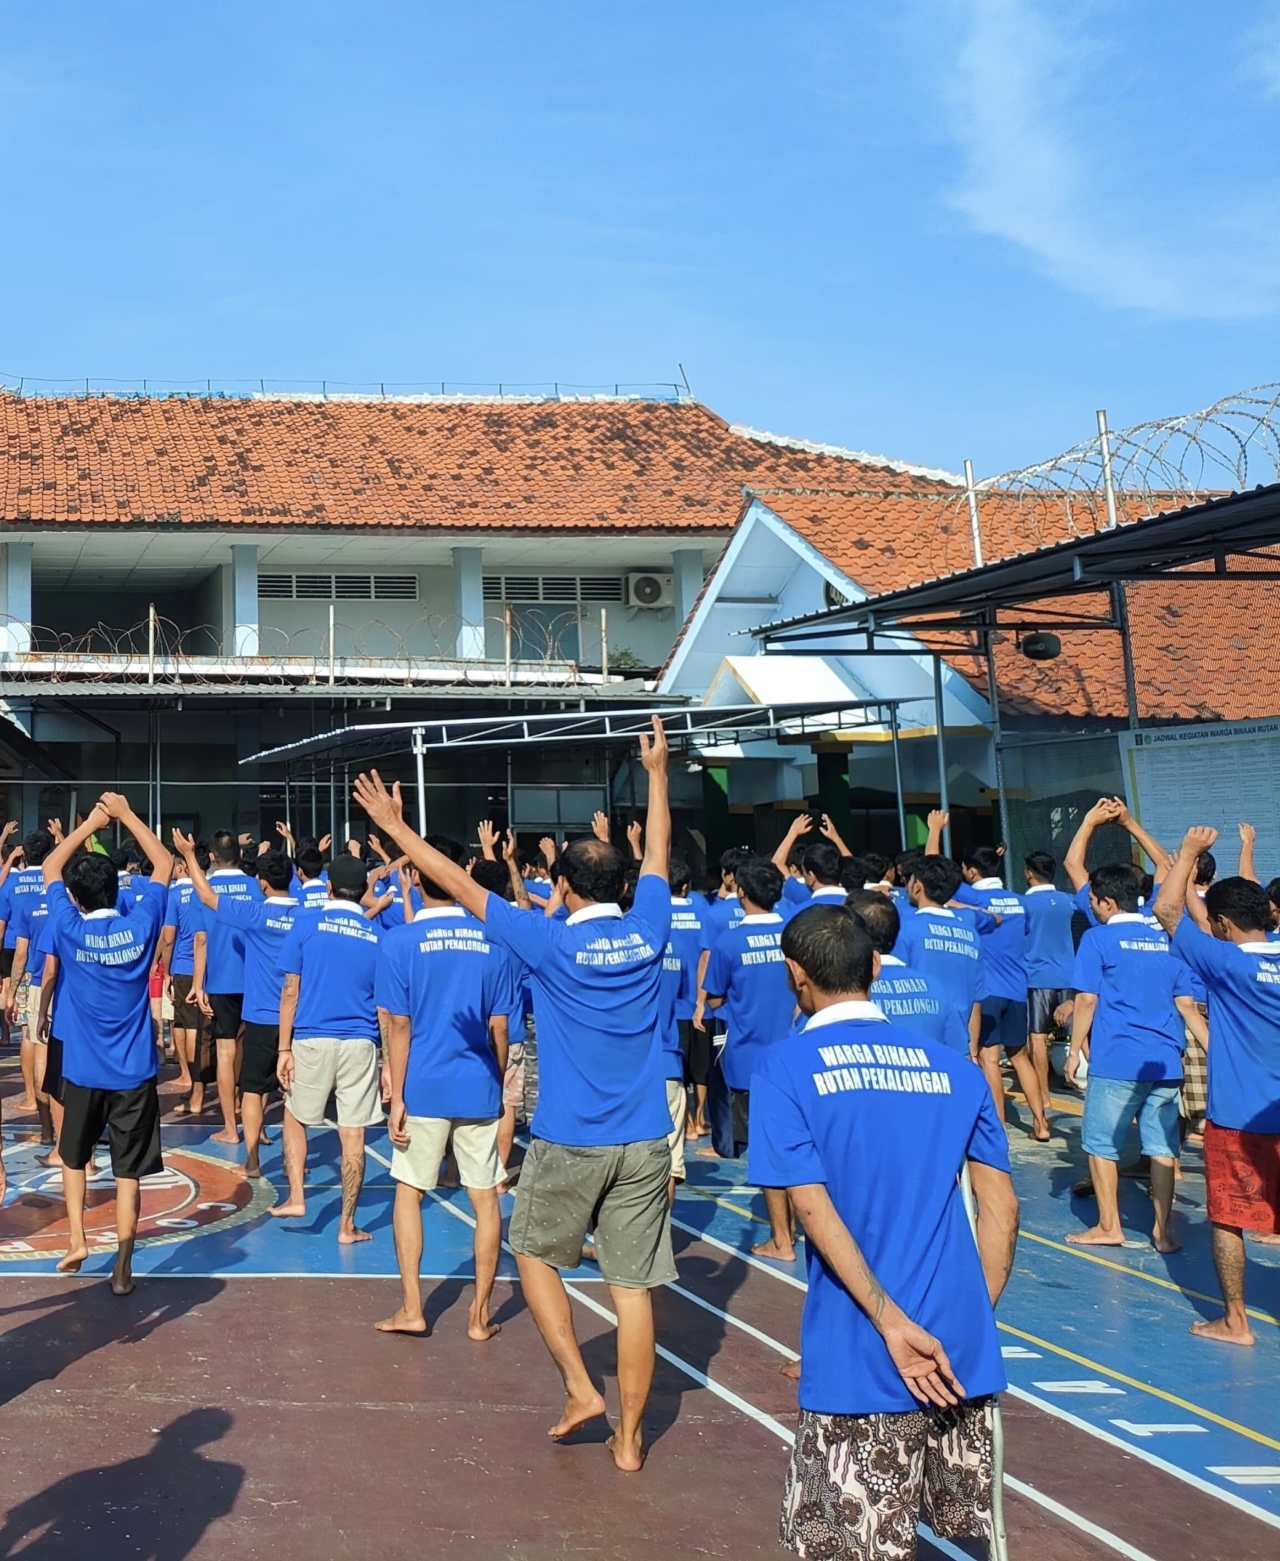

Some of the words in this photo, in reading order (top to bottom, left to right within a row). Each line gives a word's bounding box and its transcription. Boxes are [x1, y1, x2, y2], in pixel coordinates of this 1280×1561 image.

[1153, 734, 1178, 742] JADWAL
[1179, 730, 1209, 741] KEGIATAN
[1210, 728, 1233, 738] WARGA
[1233, 725, 1256, 735] BINAAN
[1257, 723, 1279, 733] RUTAN
[84, 934, 109, 949] WARGA
[108, 929, 135, 948] BINAAN
[746, 933, 775, 949] WARGA
[76, 948, 99, 963] RUTAN
[99, 943, 145, 966] PEKALONGAN
[740, 950, 766, 966] RUTAN
[892, 978, 928, 994] BINAAN
[884, 997, 940, 1016] PEKALONGAN
[817, 1043, 876, 1067] WARGA
[871, 1044, 931, 1068] BINAAN
[812, 1067, 864, 1096] RUTAN
[860, 1067, 952, 1095] PEKALONGAN
